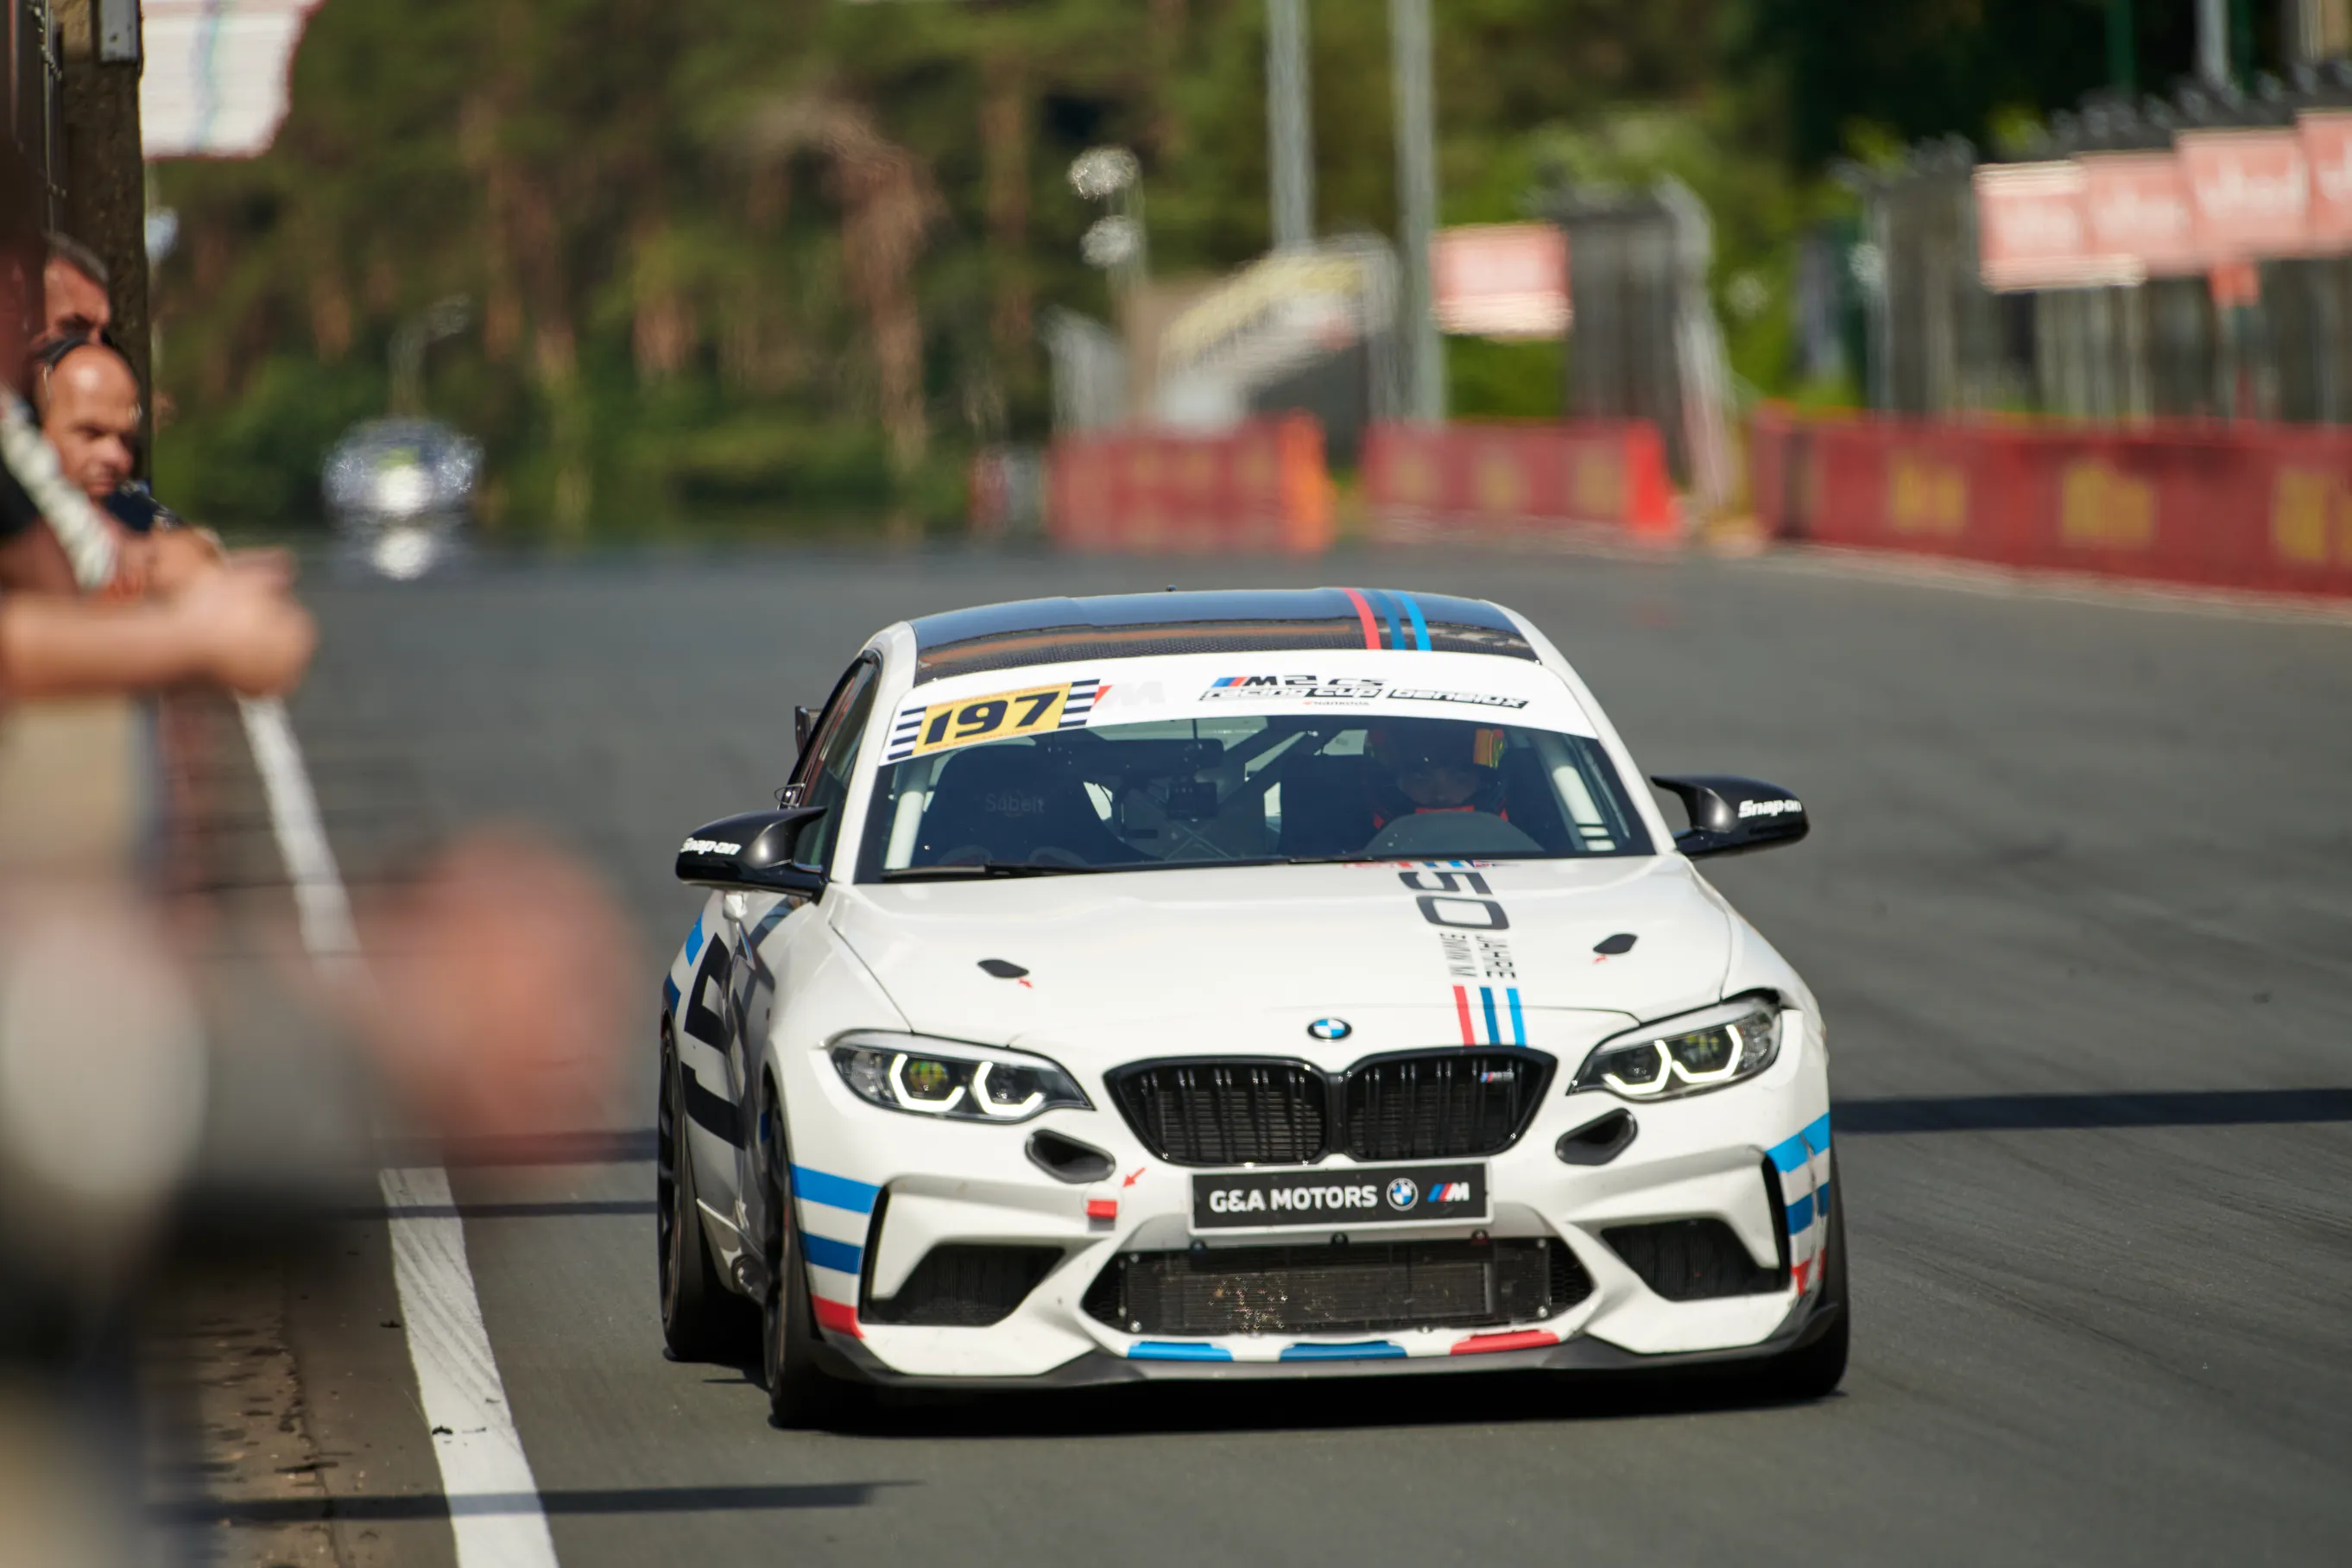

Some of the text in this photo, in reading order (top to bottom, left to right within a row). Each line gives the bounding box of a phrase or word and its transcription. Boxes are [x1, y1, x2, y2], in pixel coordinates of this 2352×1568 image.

[923, 690, 1061, 746] 197
[1308, 687, 1381, 699] cup
[1389, 688, 1528, 708] benelux
[1398, 871, 1509, 930] 50
[1210, 1190, 1266, 1213] G&A
[1270, 1185, 1378, 1211] MOTORS
[1445, 1181, 1470, 1202] M
